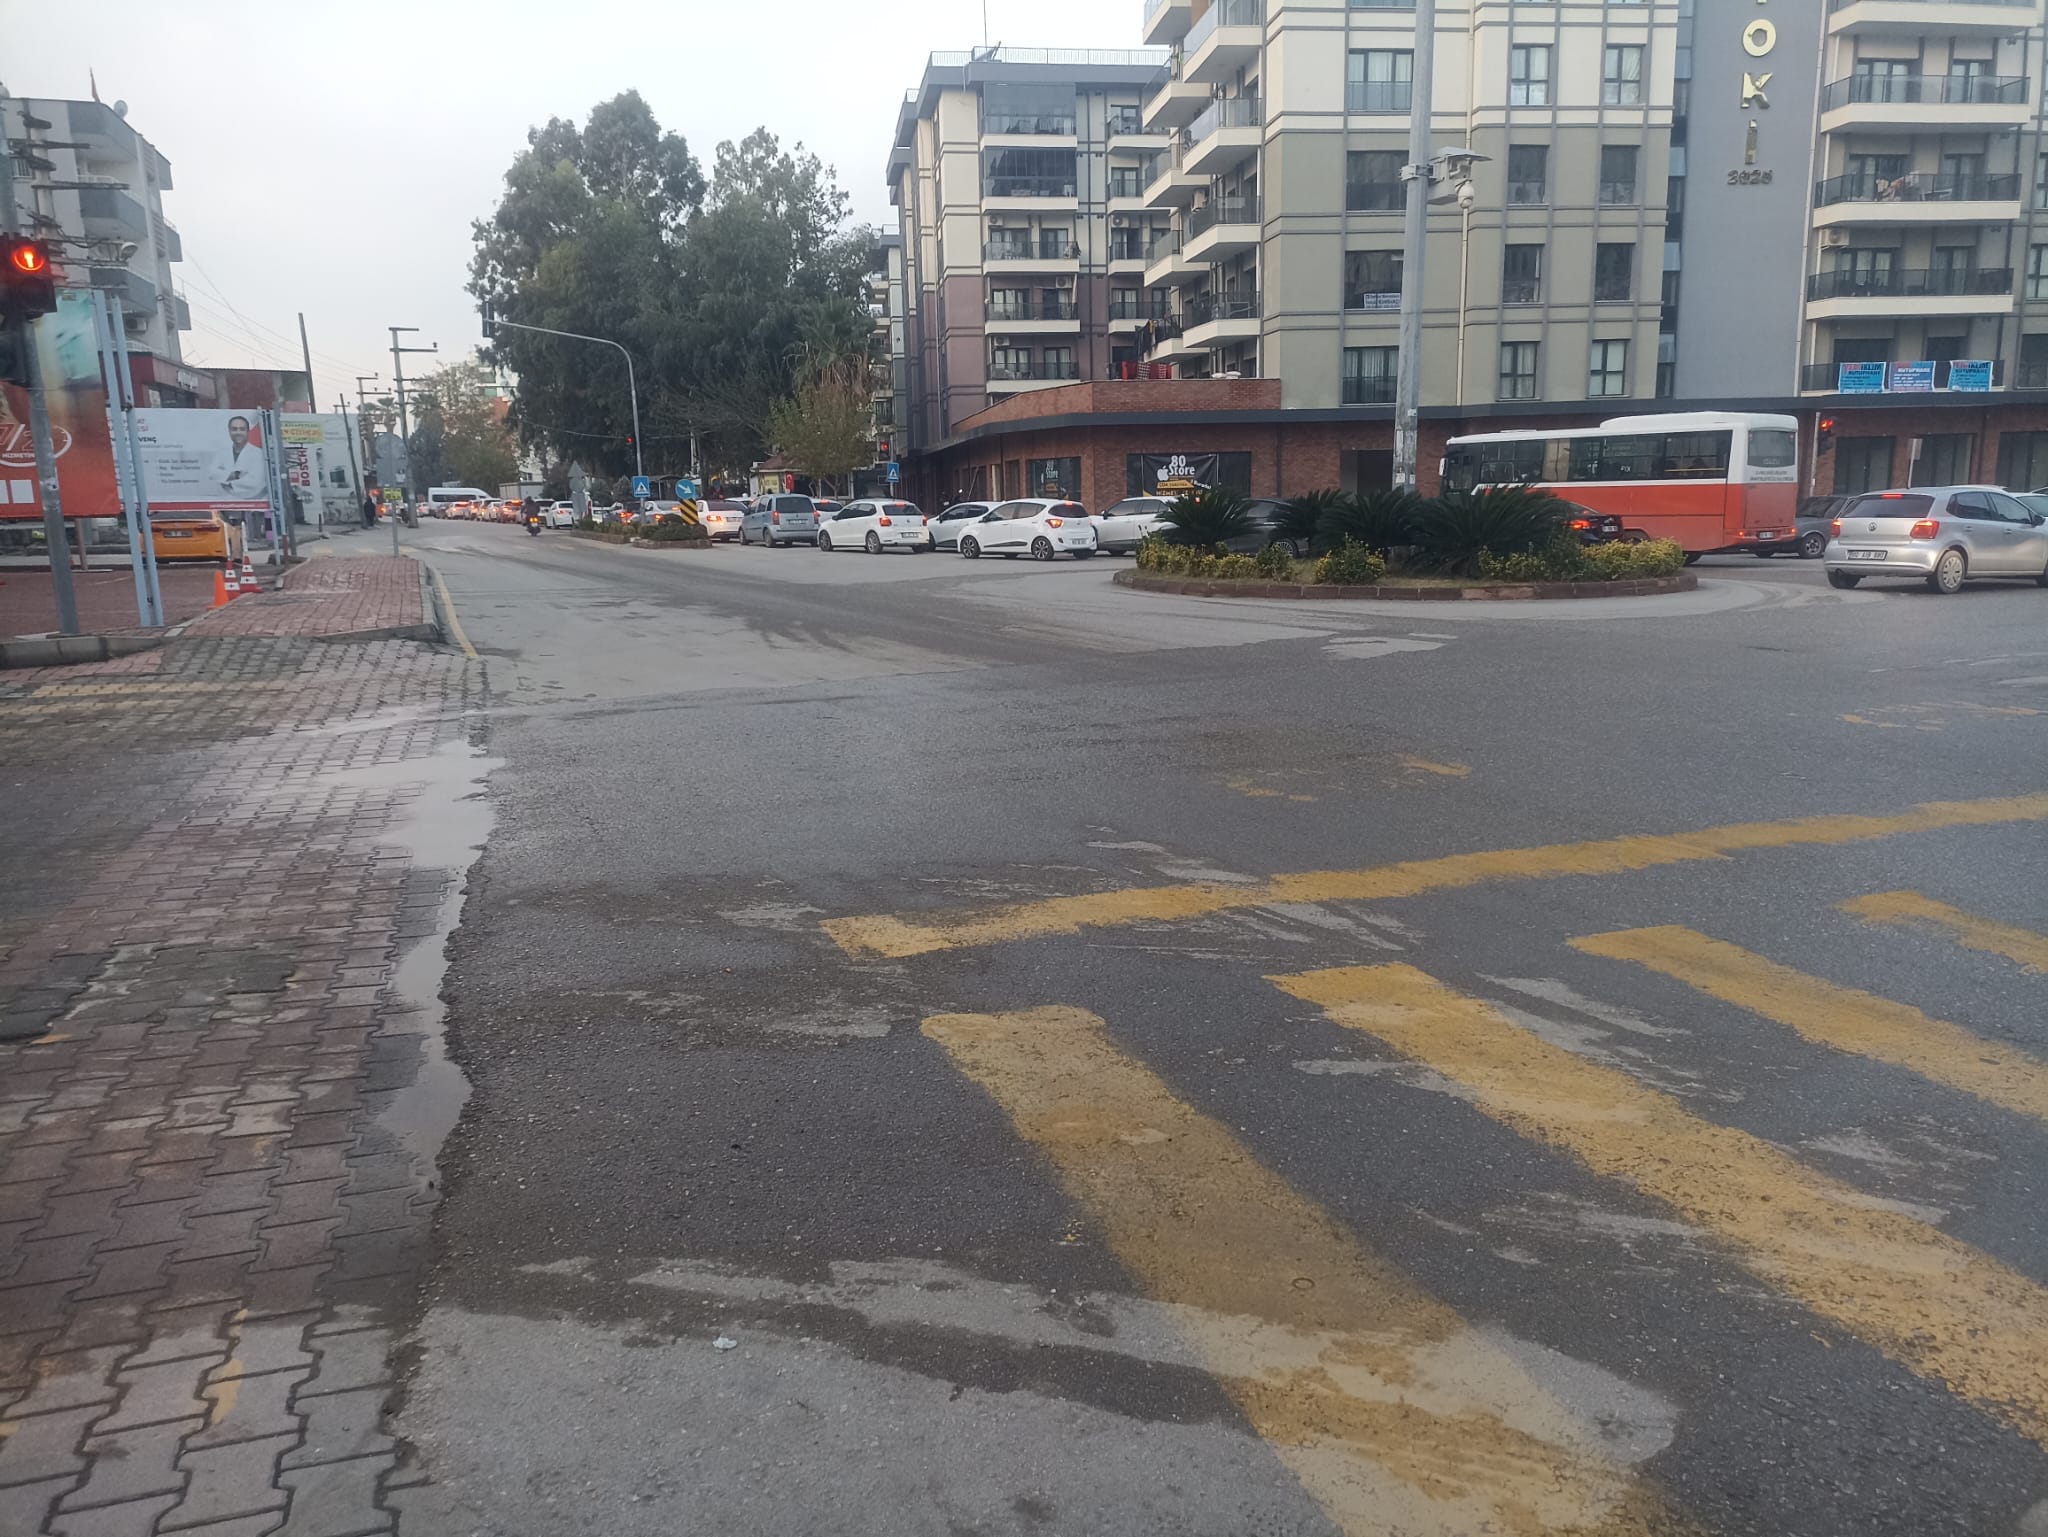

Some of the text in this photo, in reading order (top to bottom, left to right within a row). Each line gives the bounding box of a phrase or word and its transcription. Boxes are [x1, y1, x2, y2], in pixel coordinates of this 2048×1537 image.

[1740, 0, 1777, 166] OKİ
[297, 449, 310, 486] BOSCH
[1168, 463, 1196, 476] Store
[1170, 455, 1186, 467] 80
